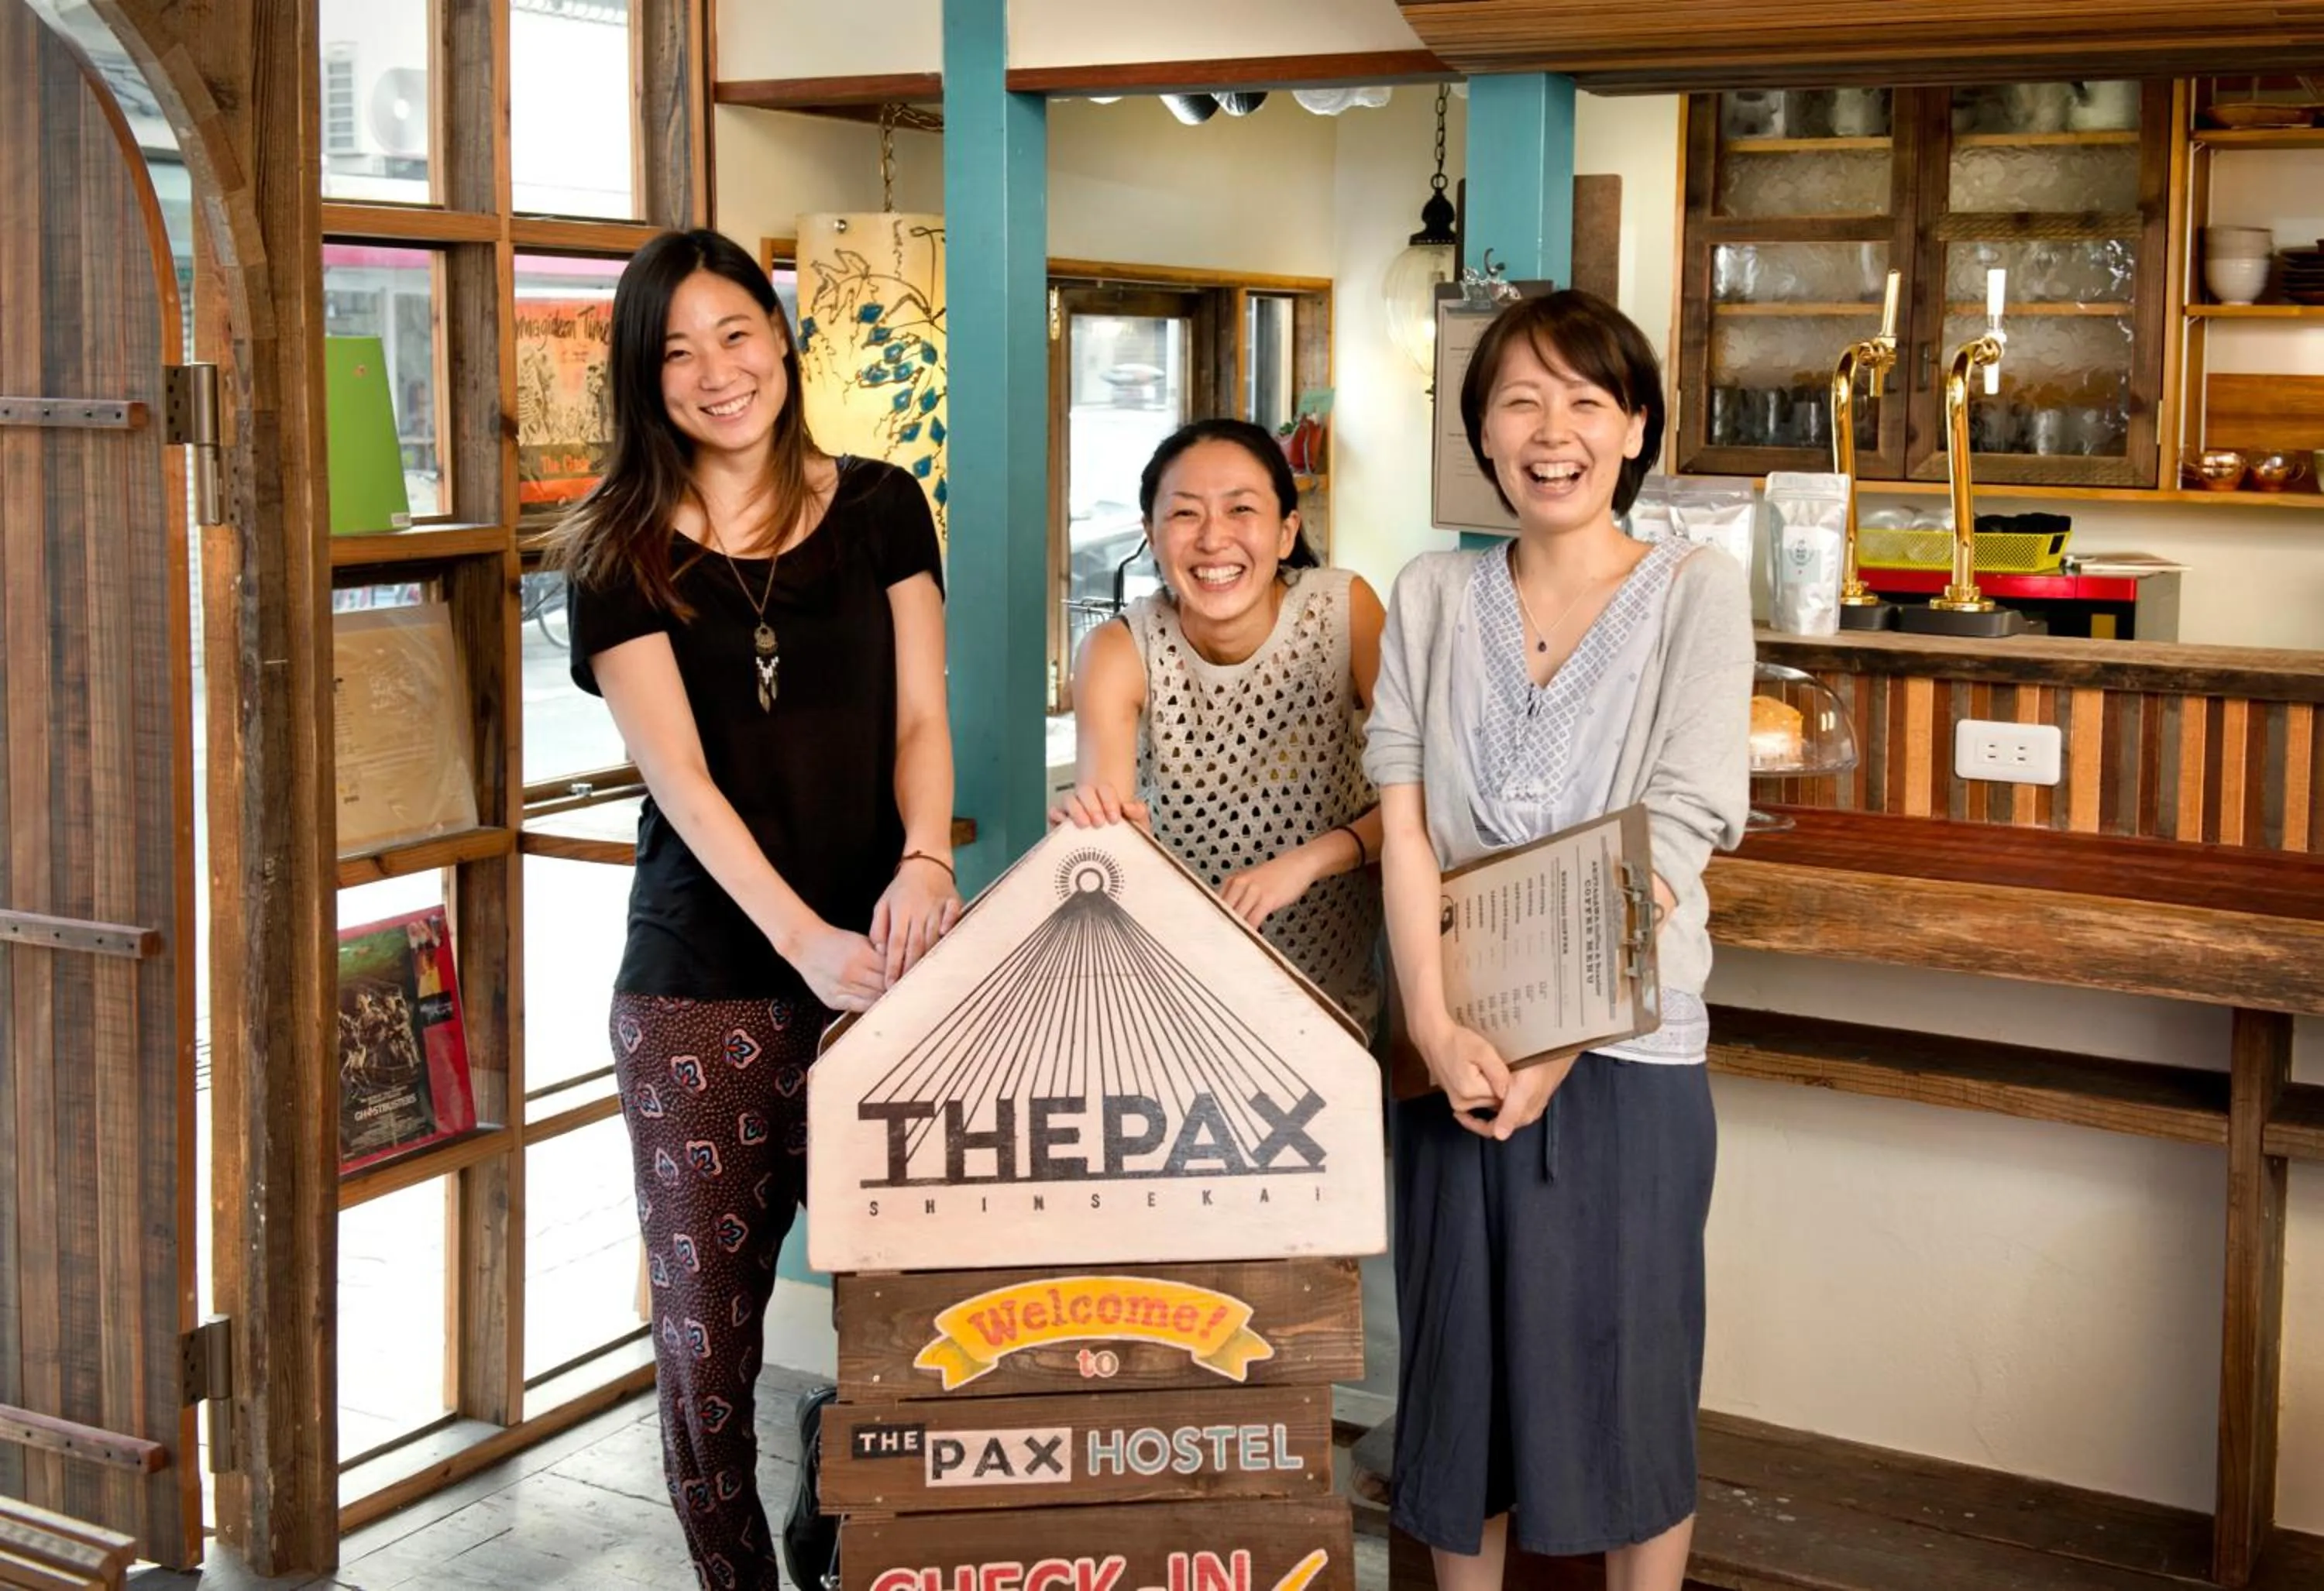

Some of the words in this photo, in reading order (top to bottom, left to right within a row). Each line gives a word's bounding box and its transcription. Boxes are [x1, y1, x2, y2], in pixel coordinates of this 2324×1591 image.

[868, 1185, 1321, 1217] SHINSEKAI
[967, 1288, 1229, 1346] Welcome!
[1076, 1348, 1119, 1378] to
[858, 1431, 919, 1453] THE
[931, 1435, 1064, 1480] PAX
[1087, 1422, 1305, 1476] HOSTEL
